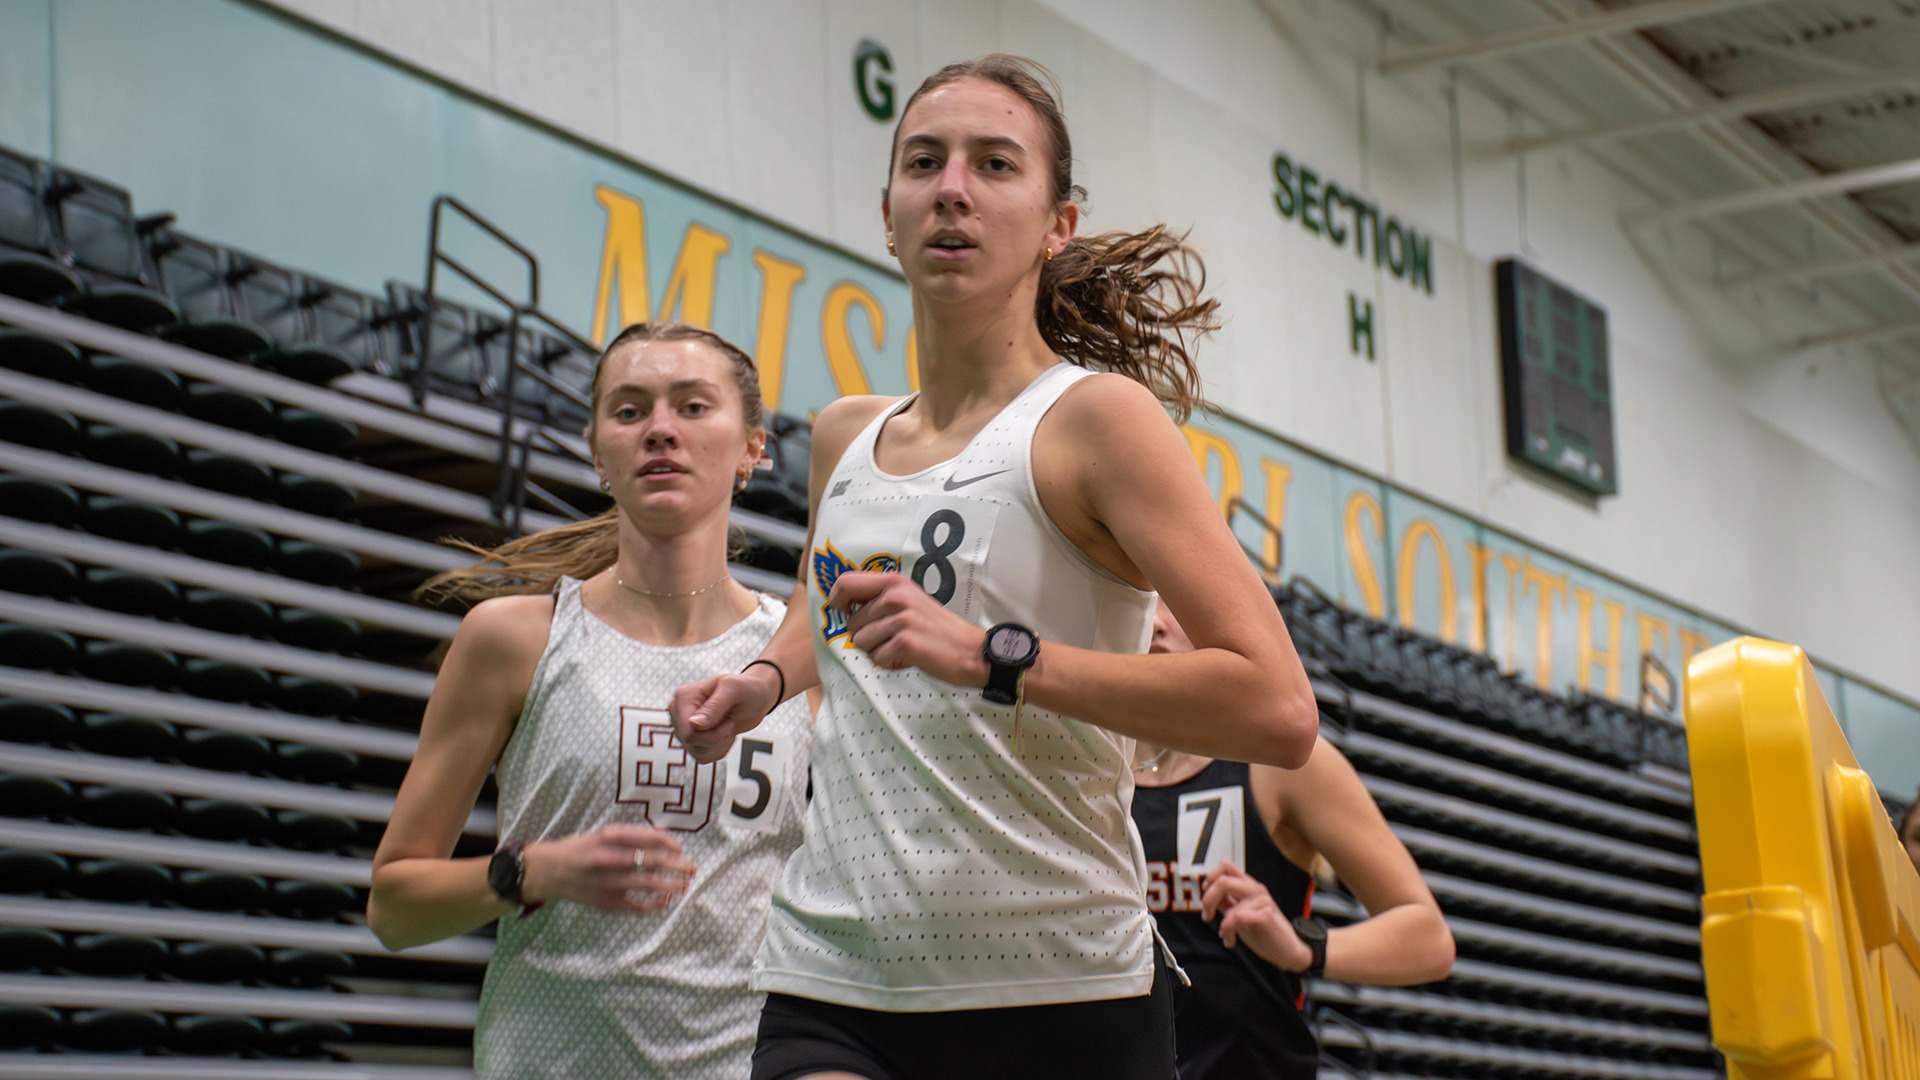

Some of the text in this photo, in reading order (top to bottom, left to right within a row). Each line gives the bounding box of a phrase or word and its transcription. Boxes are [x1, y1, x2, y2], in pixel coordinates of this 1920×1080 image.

[853, 39, 895, 124] G
[1271, 151, 1434, 297] SECTION
[1348, 292, 1376, 362] H
[911, 508, 966, 606] 8
[730, 737, 774, 820] 5
[1185, 797, 1222, 867] 7
